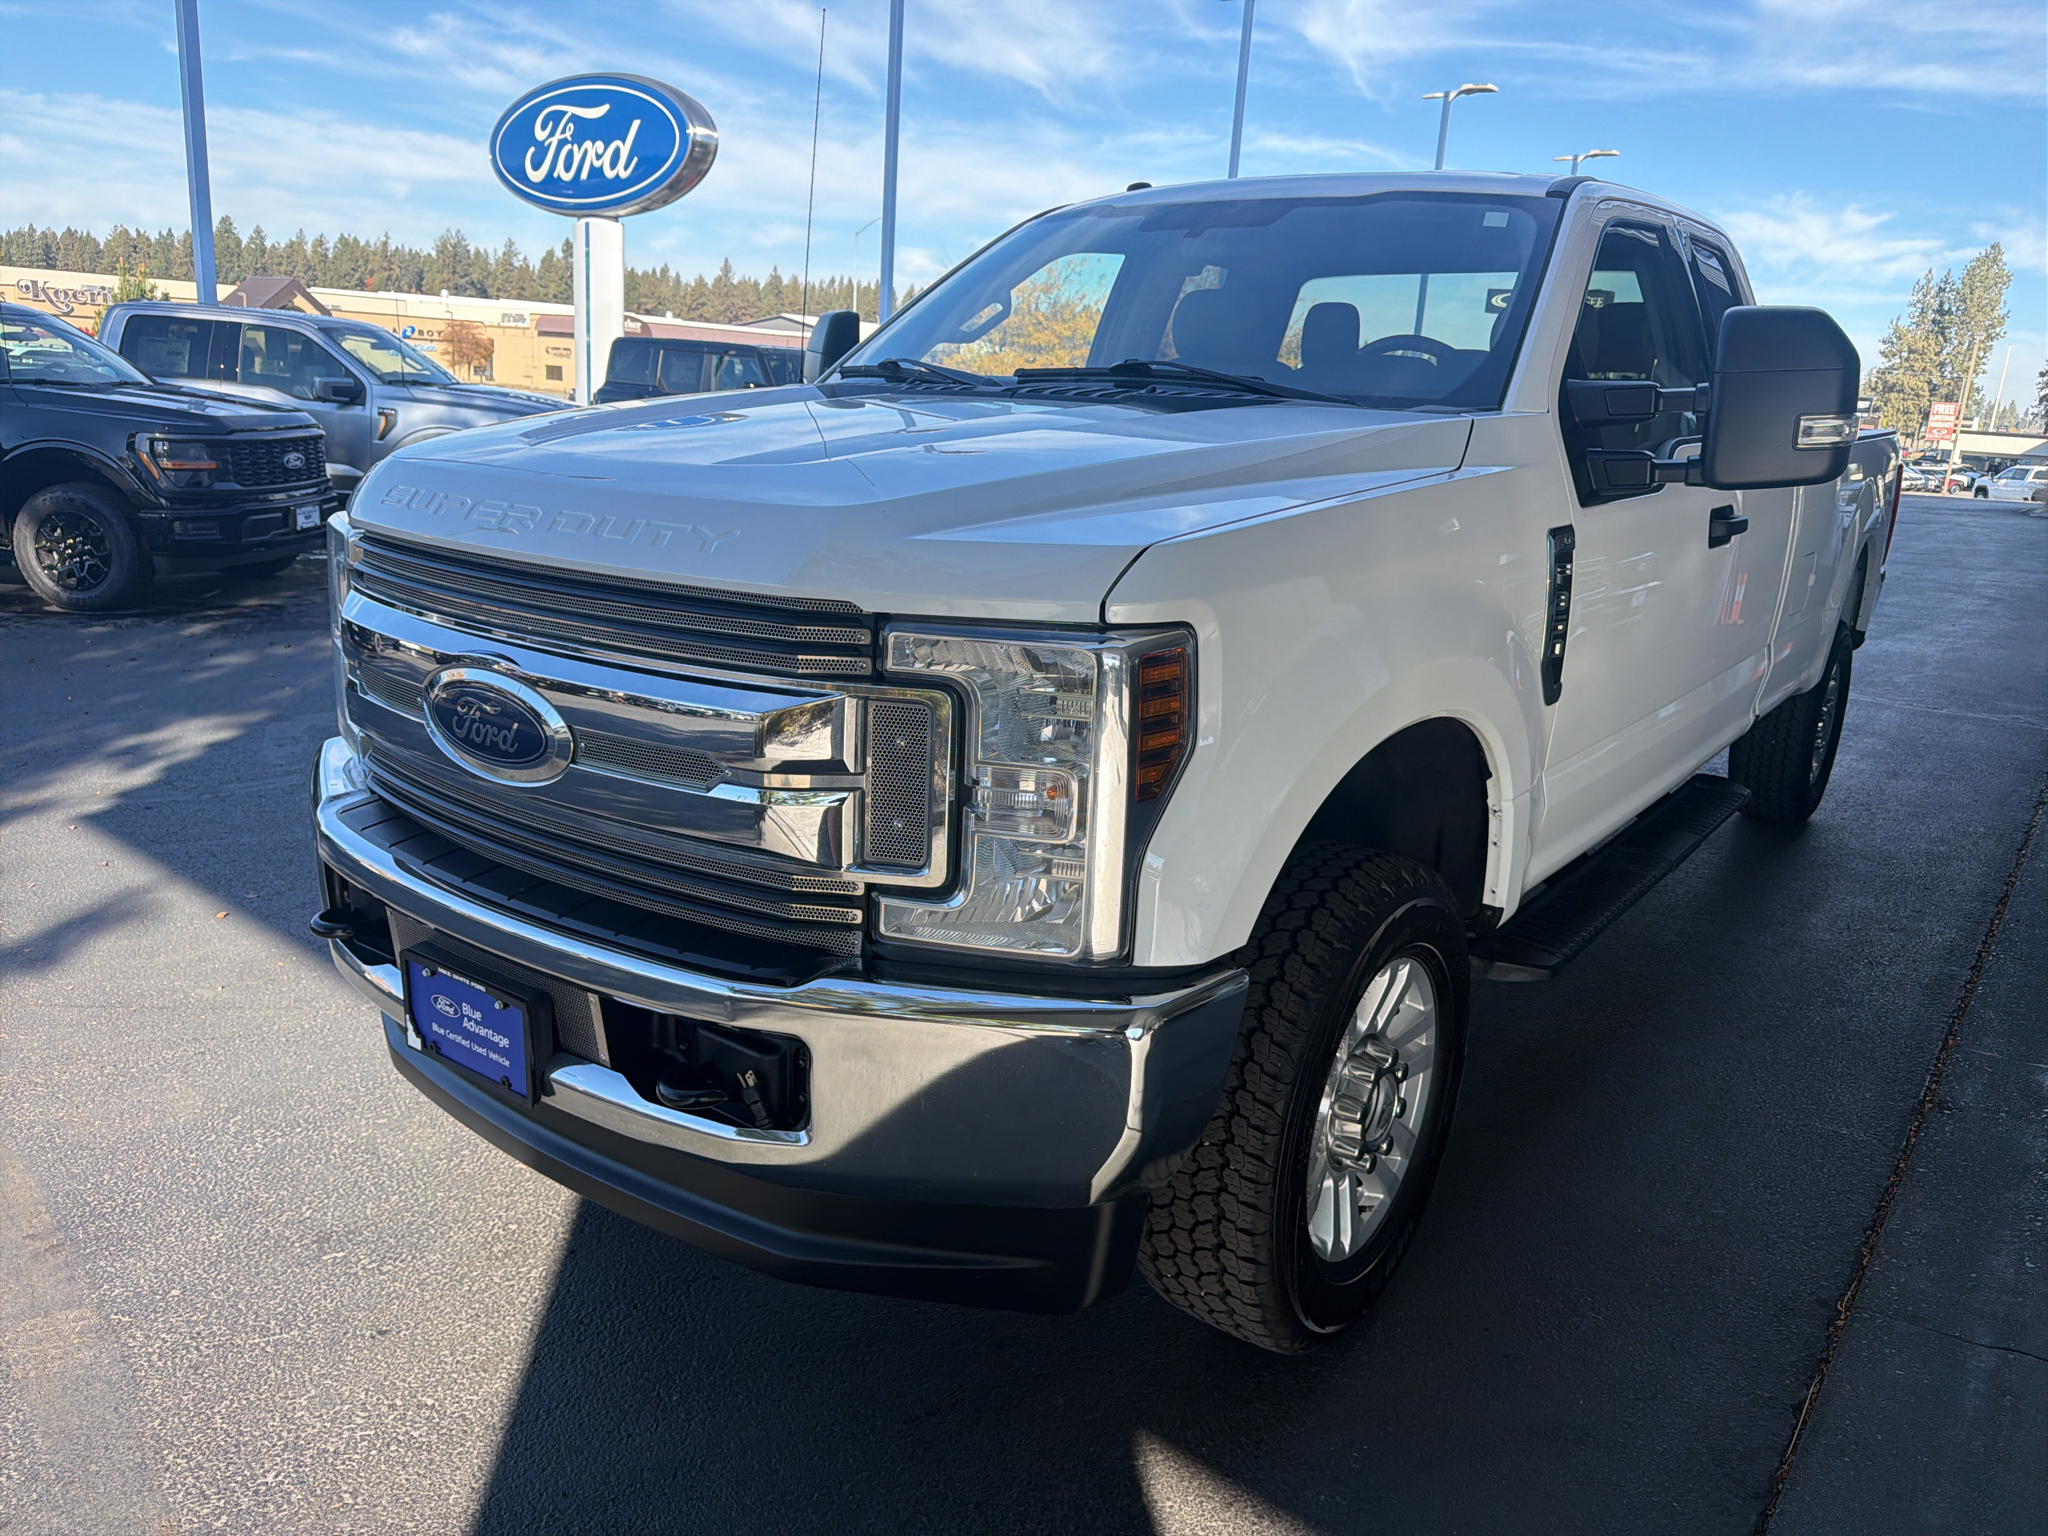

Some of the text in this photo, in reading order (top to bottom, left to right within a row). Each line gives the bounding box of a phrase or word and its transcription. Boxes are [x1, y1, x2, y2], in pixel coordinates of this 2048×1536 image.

[525, 103, 641, 183] Ford
[418, 329, 444, 337] BOY
[1933, 404, 1955, 415] FREE
[380, 484, 742, 553] SUPER DUTY
[452, 696, 519, 753] Ford
[452, 973, 470, 985] WHITE
[470, 981, 487, 992] FORD
[436, 996, 455, 1015] Ford
[462, 1002, 482, 1021] Blue
[431, 1022, 510, 1067] Blue Certified Used Vehicle
[462, 1016, 510, 1048] Advantage
